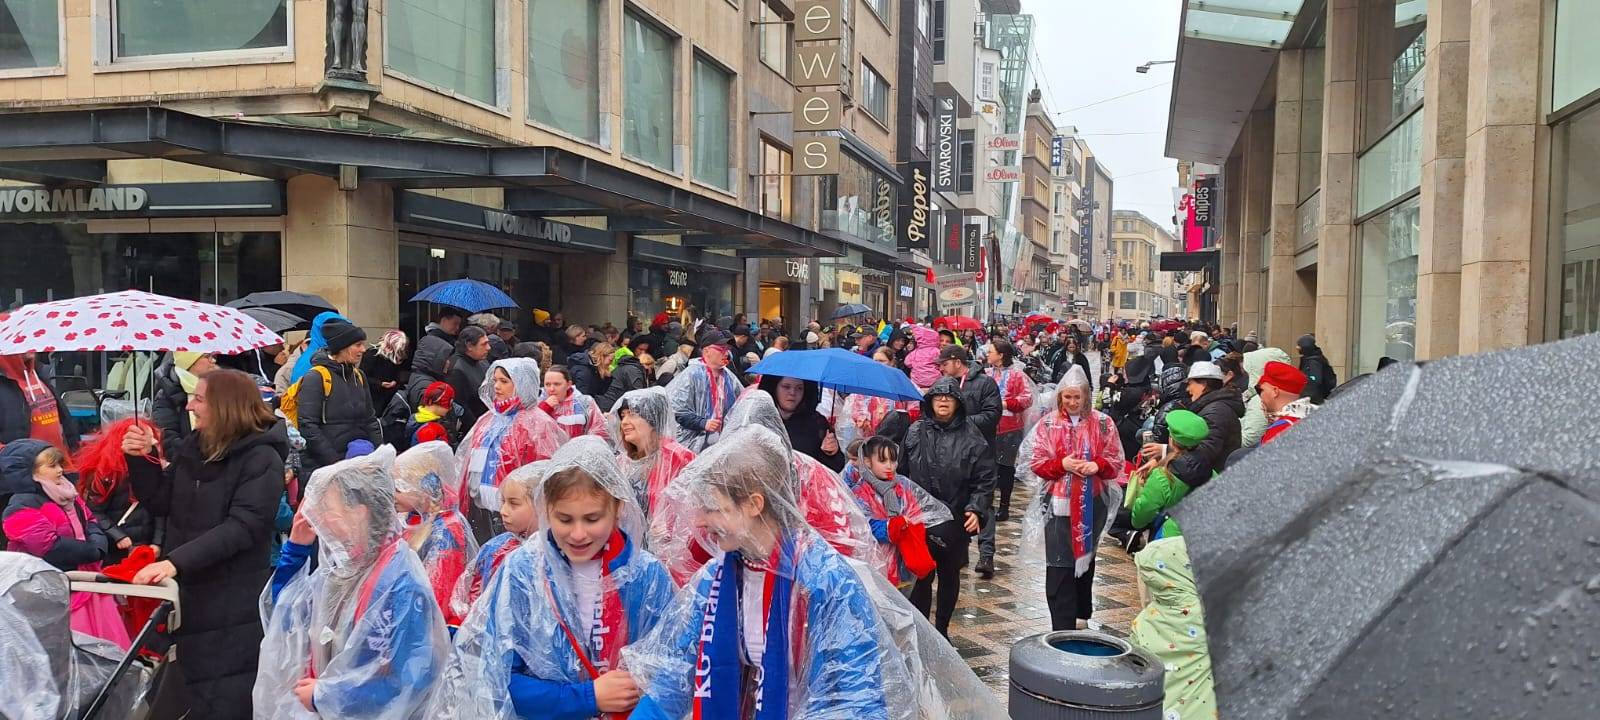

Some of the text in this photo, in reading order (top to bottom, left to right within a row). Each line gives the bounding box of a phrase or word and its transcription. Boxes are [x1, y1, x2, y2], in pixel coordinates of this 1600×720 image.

[939, 115, 952, 186] SWAROVSKI
[1053, 141, 1061, 163] KKH
[0, 187, 148, 213] WORMLAND
[908, 168, 929, 242] Pieper
[1195, 187, 1209, 222] snipes
[484, 209, 572, 244] WORMLAND
[968, 229, 977, 267] comma,
[694, 653, 711, 698] KG
